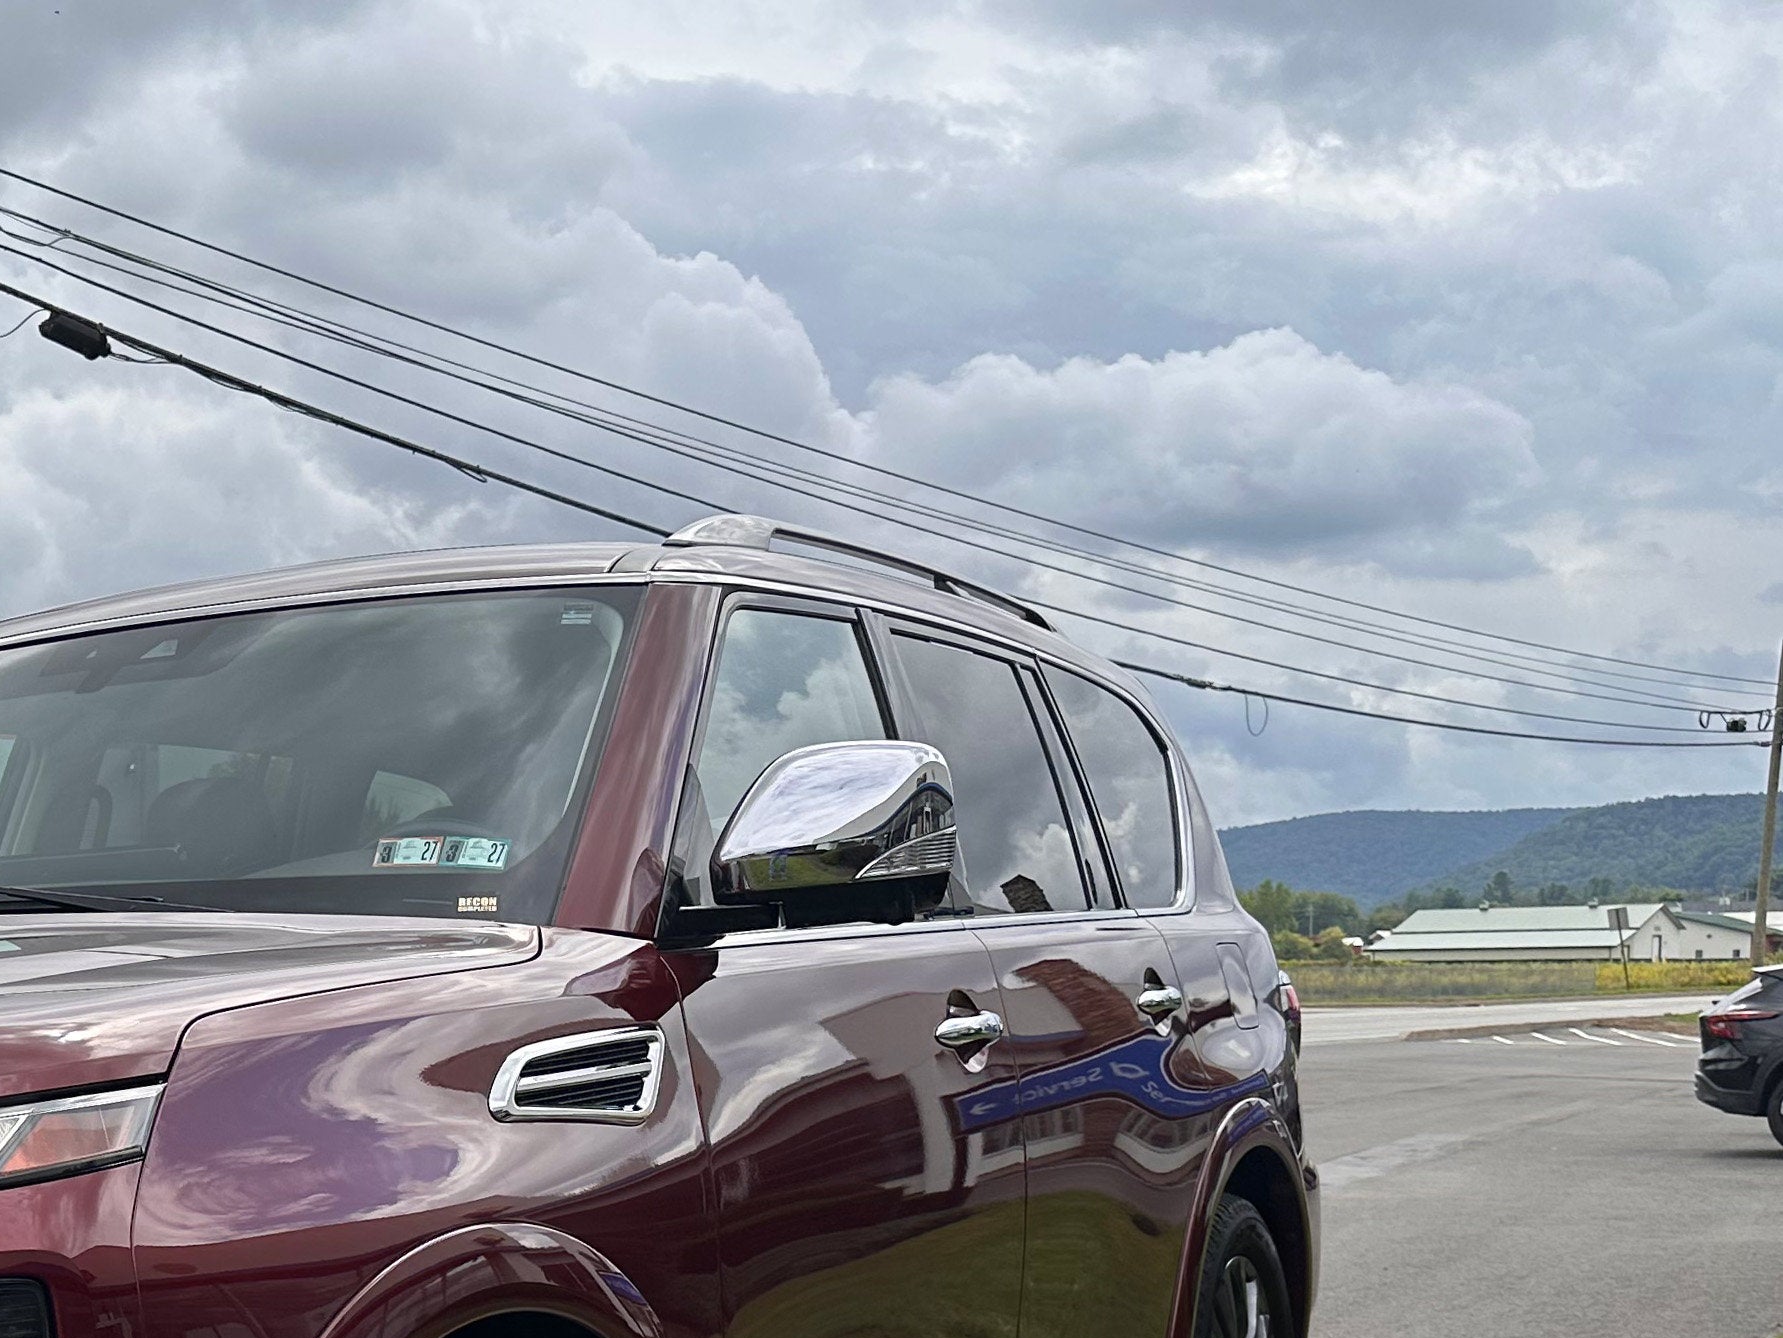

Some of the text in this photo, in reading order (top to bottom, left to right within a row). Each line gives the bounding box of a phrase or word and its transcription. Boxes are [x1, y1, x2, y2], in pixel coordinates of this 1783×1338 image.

[421, 841, 438, 861] 27
[487, 843, 506, 864] 27
[458, 897, 497, 906] RECON
